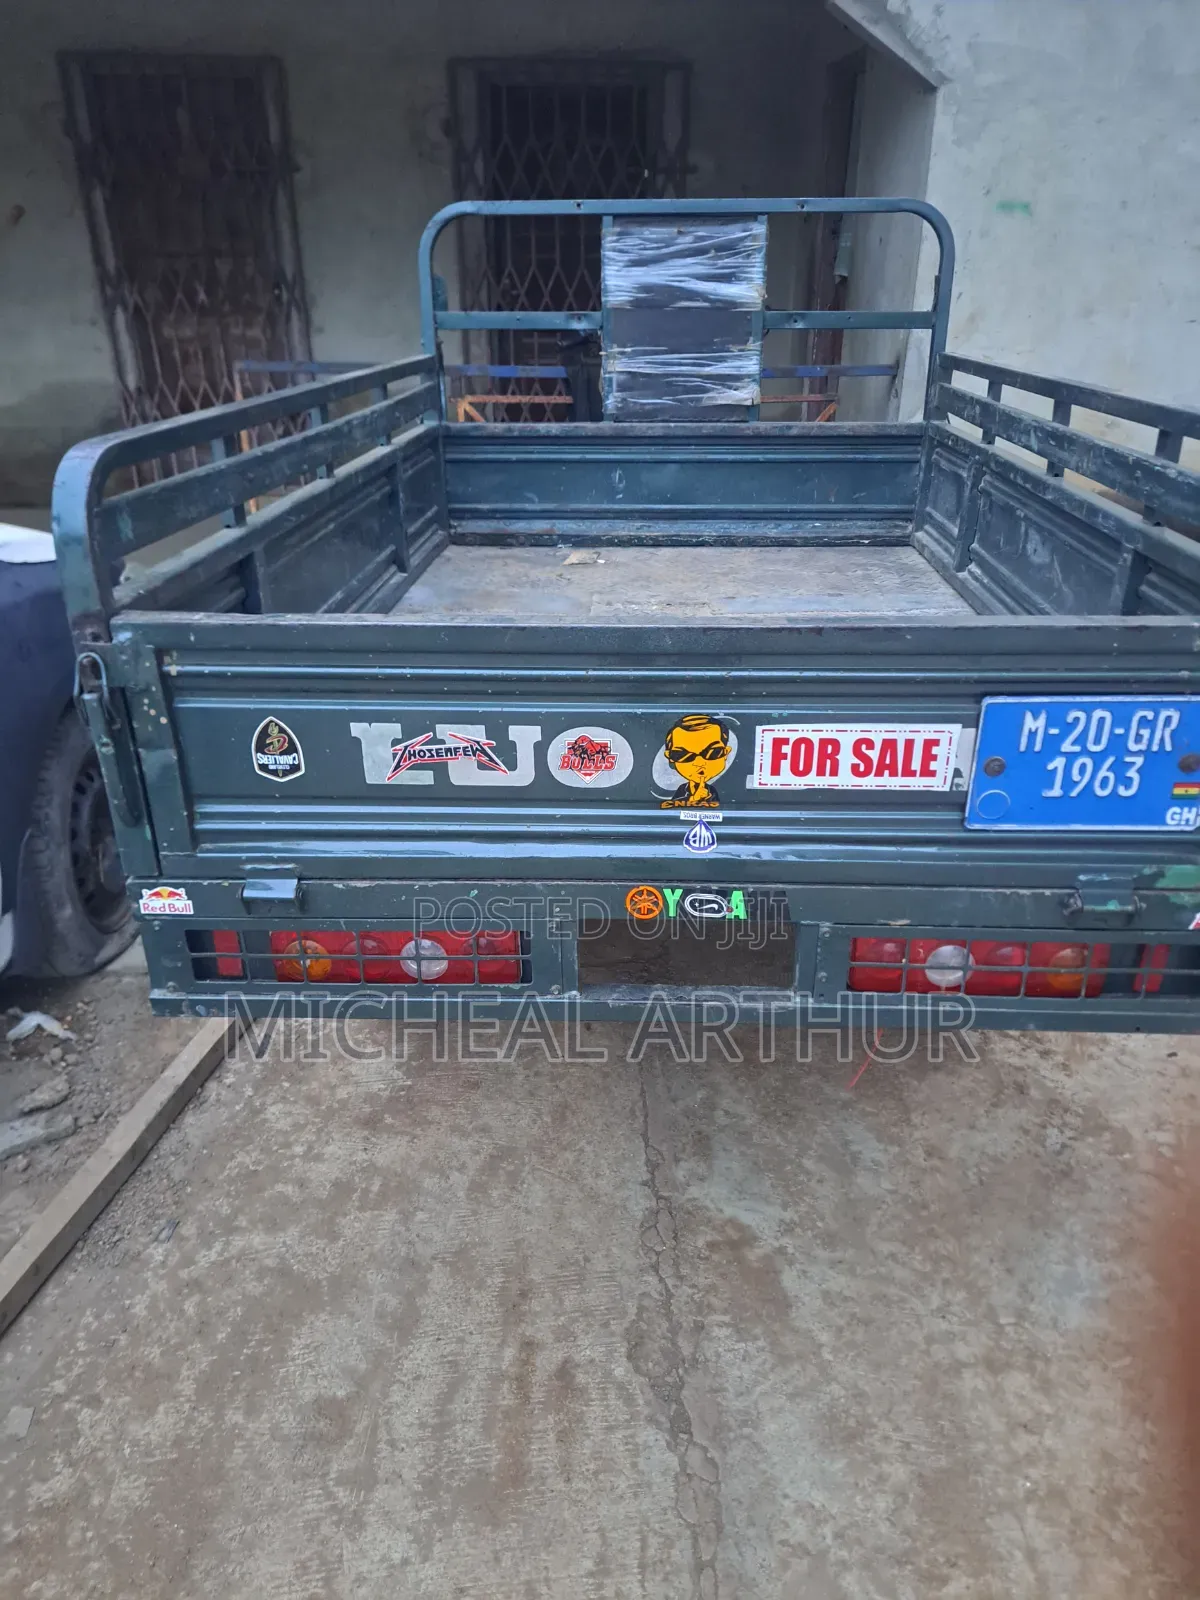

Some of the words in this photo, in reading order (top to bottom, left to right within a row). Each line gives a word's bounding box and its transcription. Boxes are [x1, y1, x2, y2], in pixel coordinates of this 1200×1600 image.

[1019, 708, 1180, 752] M-20-GR
[256, 752, 299, 765] CAVALIERS
[559, 754, 617, 771] BULLS
[770, 737, 841, 777] FOR
[851, 737, 940, 778] SALE
[1041, 755, 1145, 798] 1963
[1165, 806, 1200, 825] GH
[142, 902, 167, 912] Red
[167, 902, 192, 913] Bull
